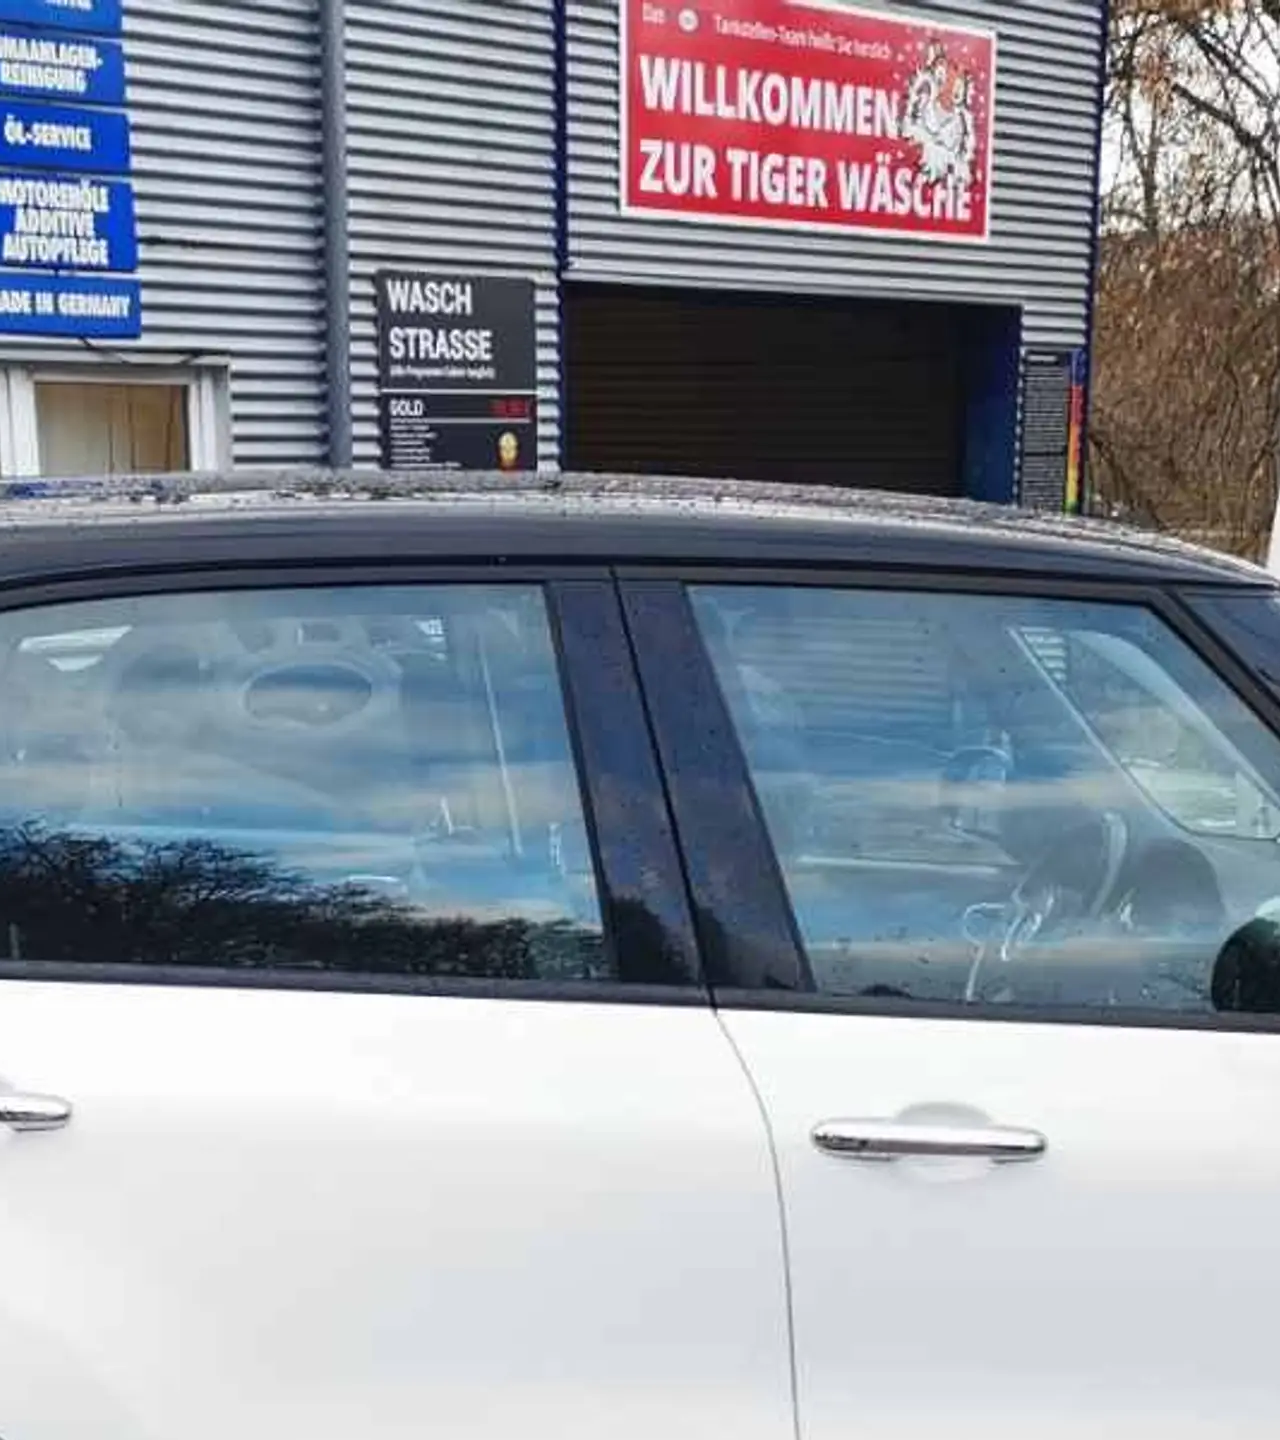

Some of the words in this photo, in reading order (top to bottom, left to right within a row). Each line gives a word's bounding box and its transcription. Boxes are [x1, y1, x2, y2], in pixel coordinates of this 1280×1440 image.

[0, 61, 87, 93] REINIGUNG
[639, 55, 900, 138] WILLKOMMEN
[4, 114, 91, 150] ÖL-SERVICE
[639, 139, 717, 199] ZUR
[726, 148, 828, 208] TIGER
[837, 152, 972, 221] WÄSCHE
[15, 208, 95, 237] ADDITIVE
[3, 234, 109, 266] AUTOPFLEGE
[35, 292, 53, 314] IN
[59, 294, 130, 317] GERMANY
[386, 278, 473, 315] WASCH
[389, 326, 493, 361] STRASSE
